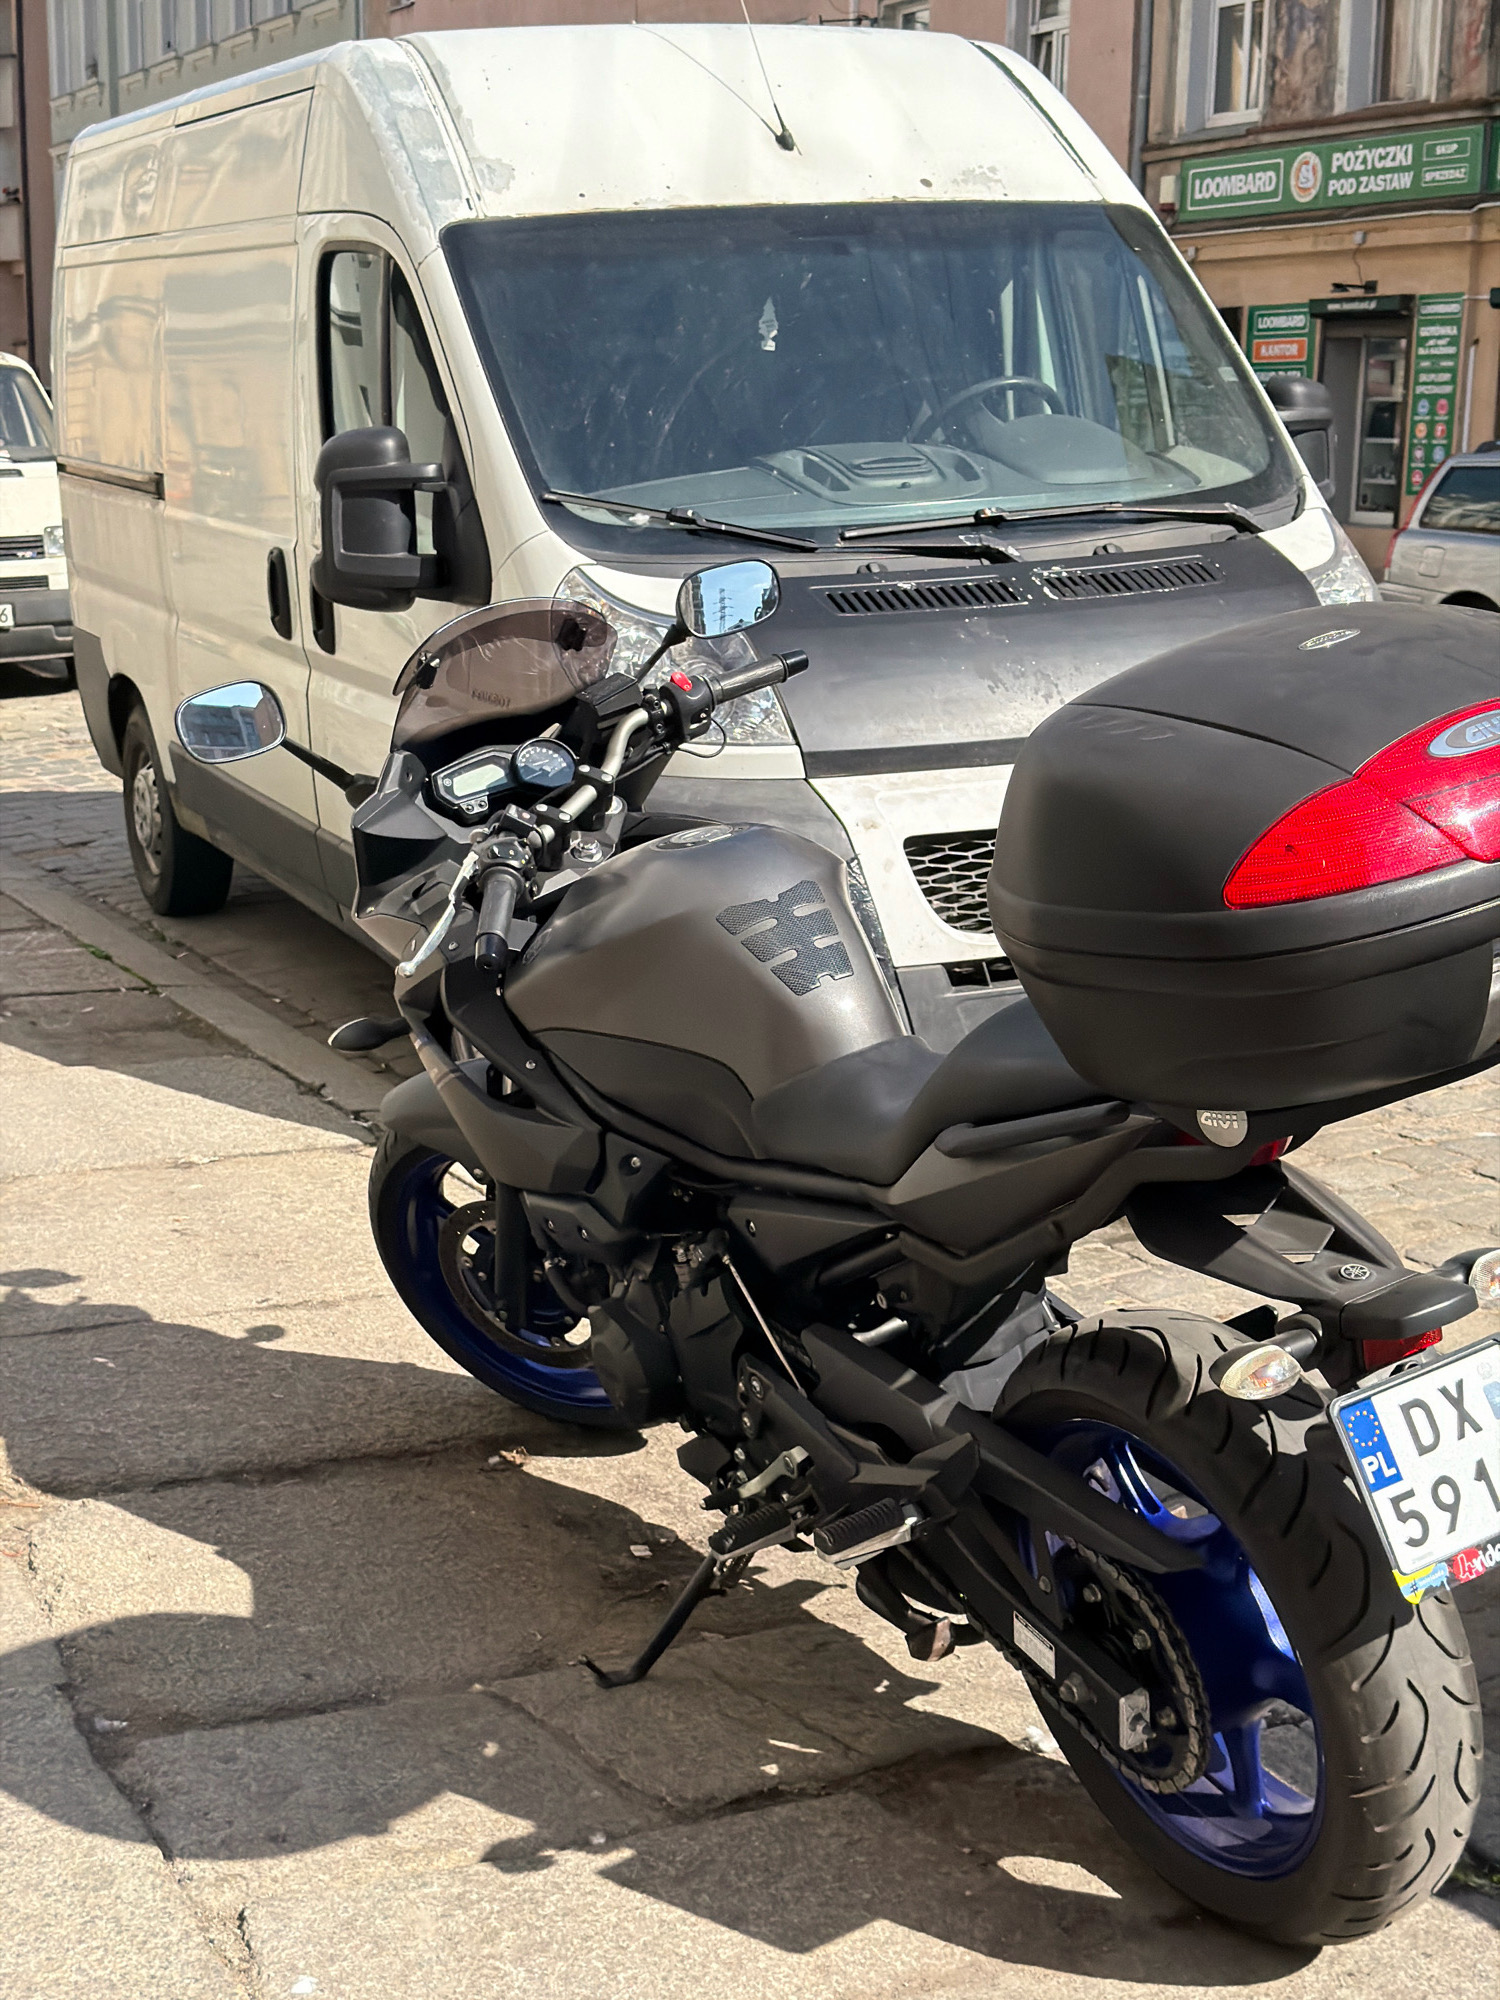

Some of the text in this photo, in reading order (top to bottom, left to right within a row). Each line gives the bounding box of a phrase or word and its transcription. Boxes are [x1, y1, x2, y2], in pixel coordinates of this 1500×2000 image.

[1331, 144, 1413, 173] POŻYCZKI
[1436, 143, 1459, 155] SKUP
[1194, 170, 1277, 200] LOOMBARD
[1328, 171, 1414, 197] POD ZASTAW
[1257, 314, 1306, 329] LOOMBARD
[1260, 343, 1299, 357] KANTOR
[0, 607, 8, 623] 6
[1201, 1112, 1239, 1129] GIVI
[1399, 1378, 1483, 1456] DX
[1361, 1451, 1397, 1484] PL
[1389, 1457, 1500, 1548] 591
